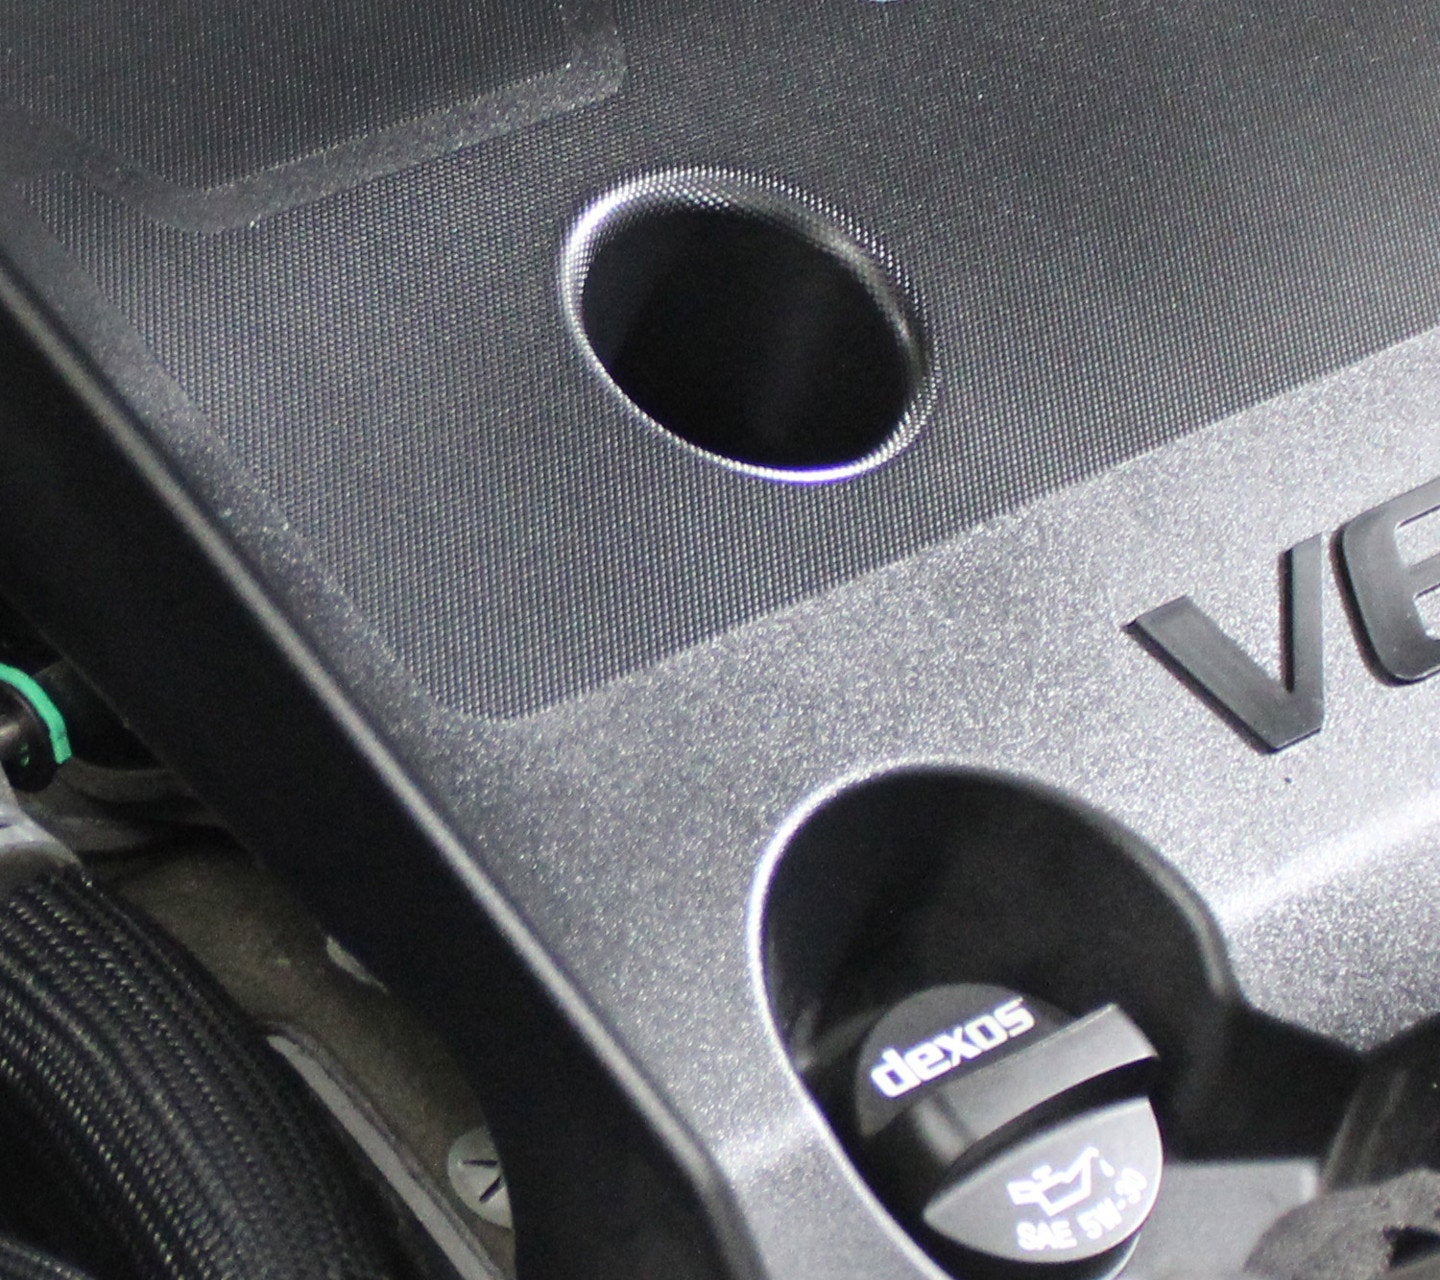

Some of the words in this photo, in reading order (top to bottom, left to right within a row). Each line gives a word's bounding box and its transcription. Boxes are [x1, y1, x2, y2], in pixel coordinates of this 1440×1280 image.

[871, 997, 1036, 1098] dexos
[1016, 1220, 1077, 1251] SAE
[1077, 1167, 1148, 1240] 5W-30
